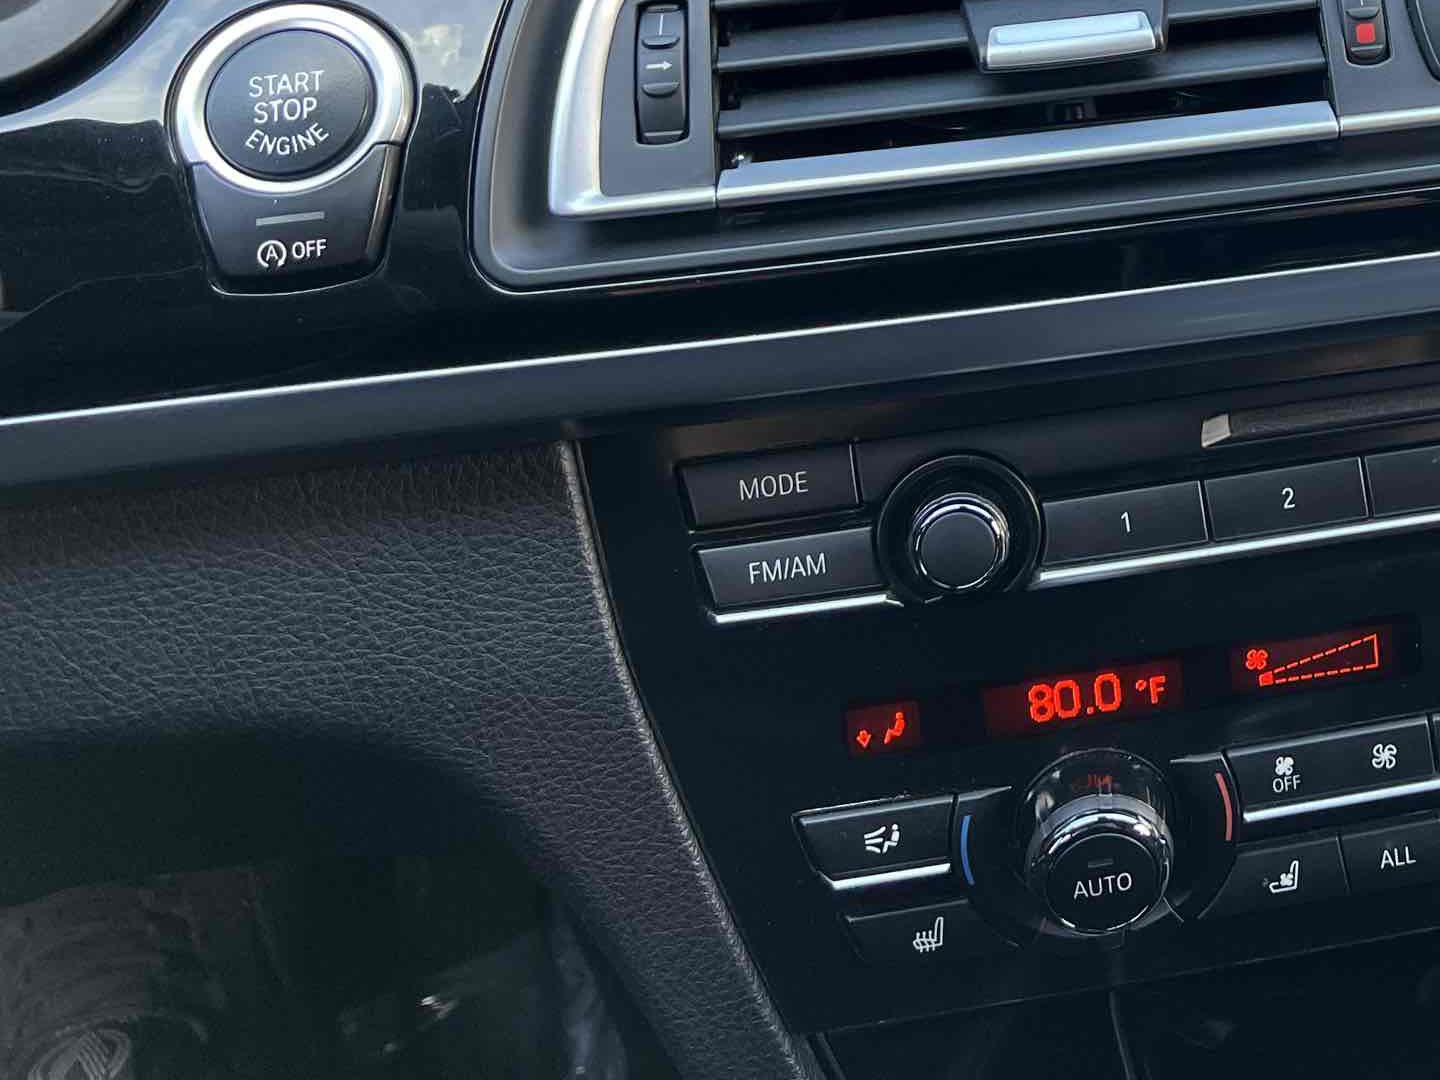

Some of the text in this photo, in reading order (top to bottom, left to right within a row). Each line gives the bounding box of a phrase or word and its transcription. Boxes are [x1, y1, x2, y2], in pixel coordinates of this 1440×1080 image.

[249, 70, 325, 98] START
[254, 97, 318, 124] STOP
[245, 122, 330, 156] ENGINE
[292, 238, 328, 260] OFF
[738, 470, 809, 501] MODE
[1281, 486, 1296, 510] 2
[1119, 510, 1132, 536] 1
[748, 551, 828, 585] FM/AM
[1026, 672, 1122, 723] 80.0
[1272, 775, 1302, 794] OFF
[1380, 846, 1418, 870] ALL
[1073, 871, 1134, 900] AUTO
